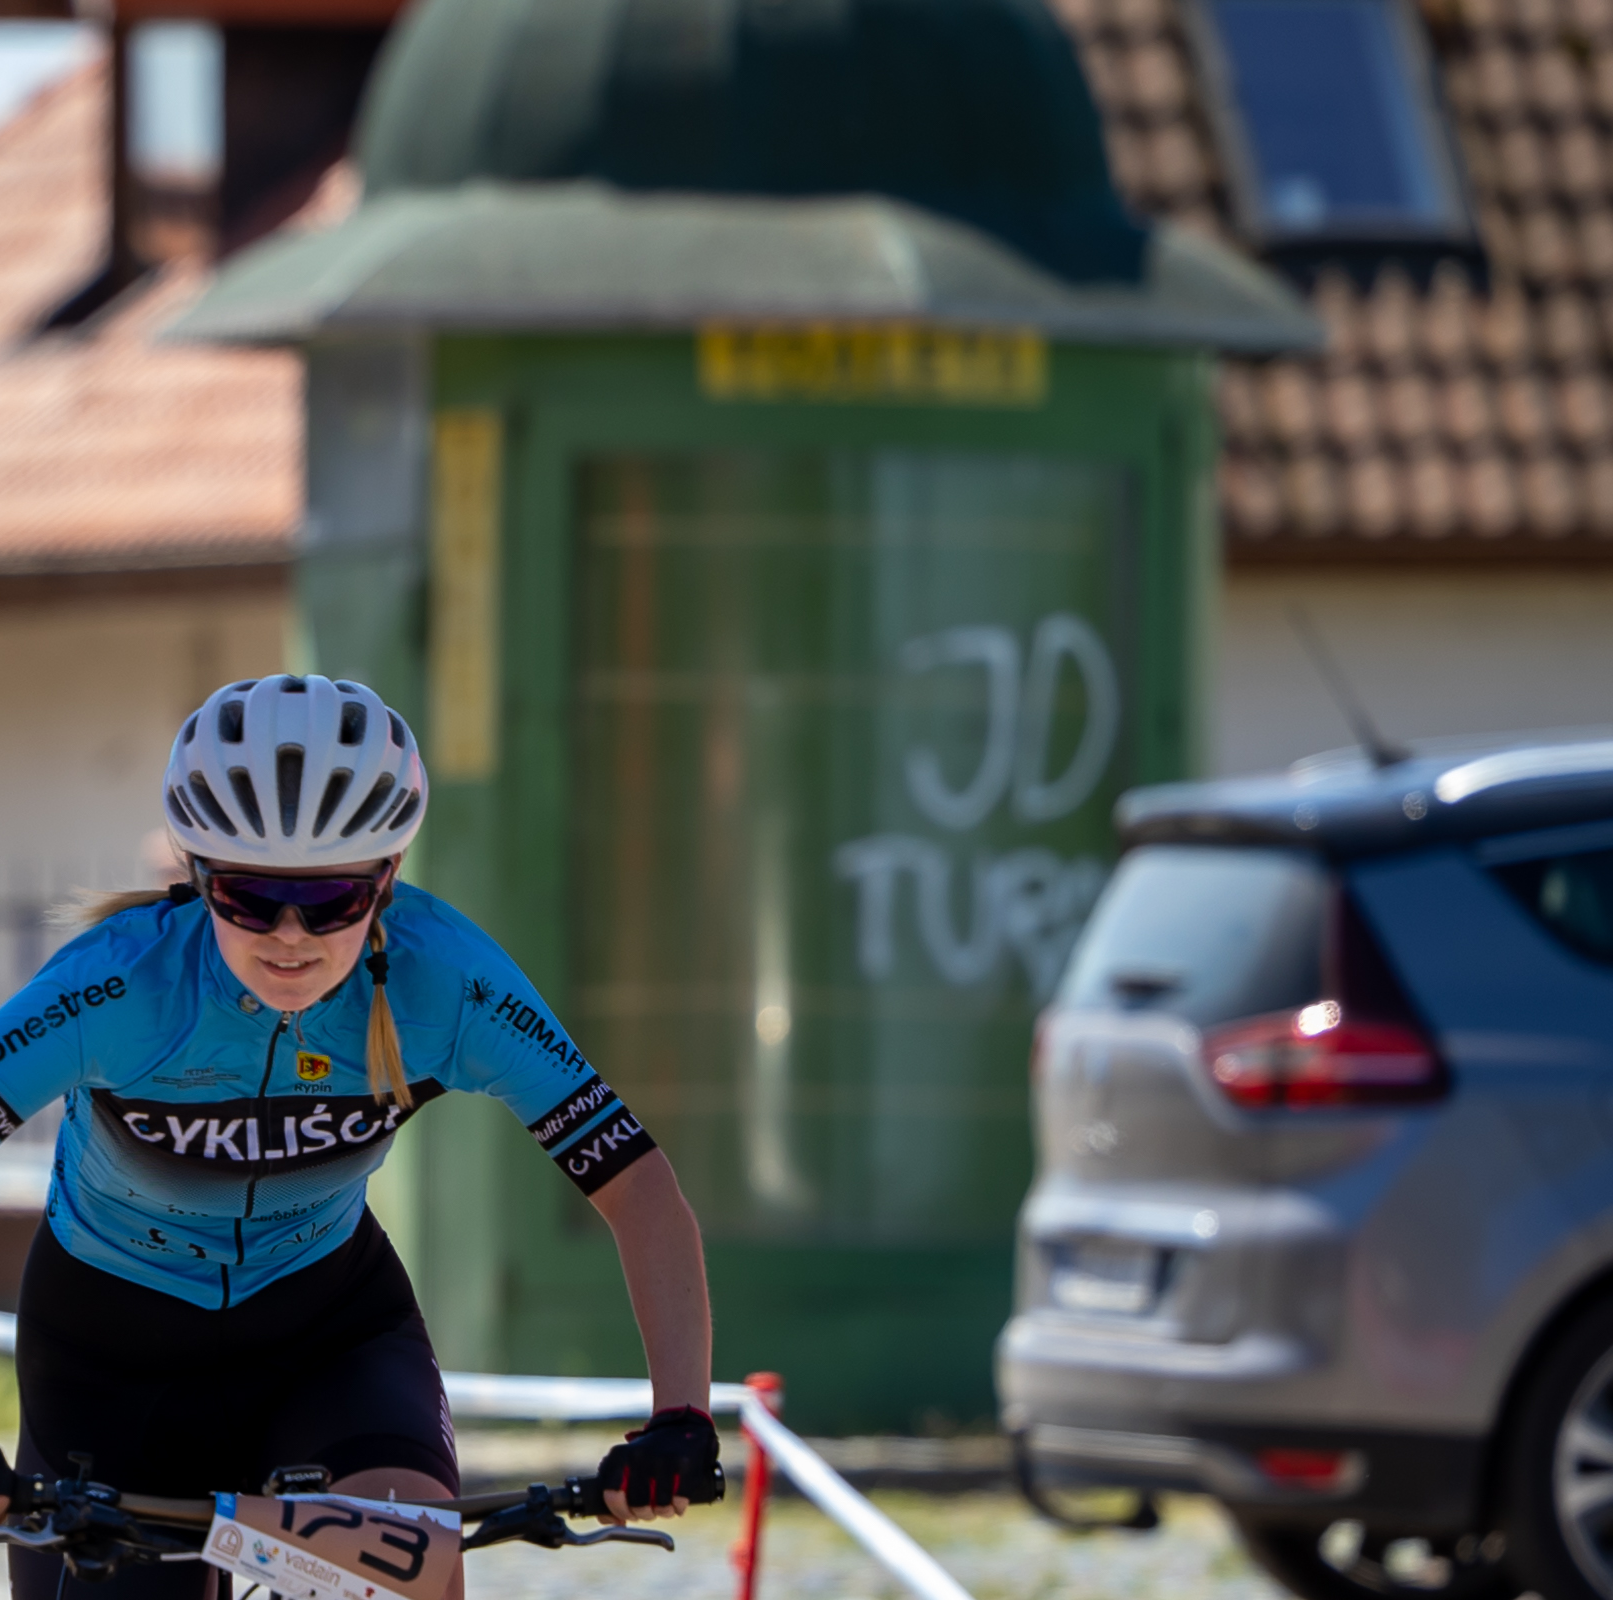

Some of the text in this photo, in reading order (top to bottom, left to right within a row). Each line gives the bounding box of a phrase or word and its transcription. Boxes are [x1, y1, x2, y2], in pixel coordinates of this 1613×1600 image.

[495, 992, 587, 1074] KOMAR
[293, 1081, 333, 1095] Rypin
[568, 1111, 644, 1176] CYKL
